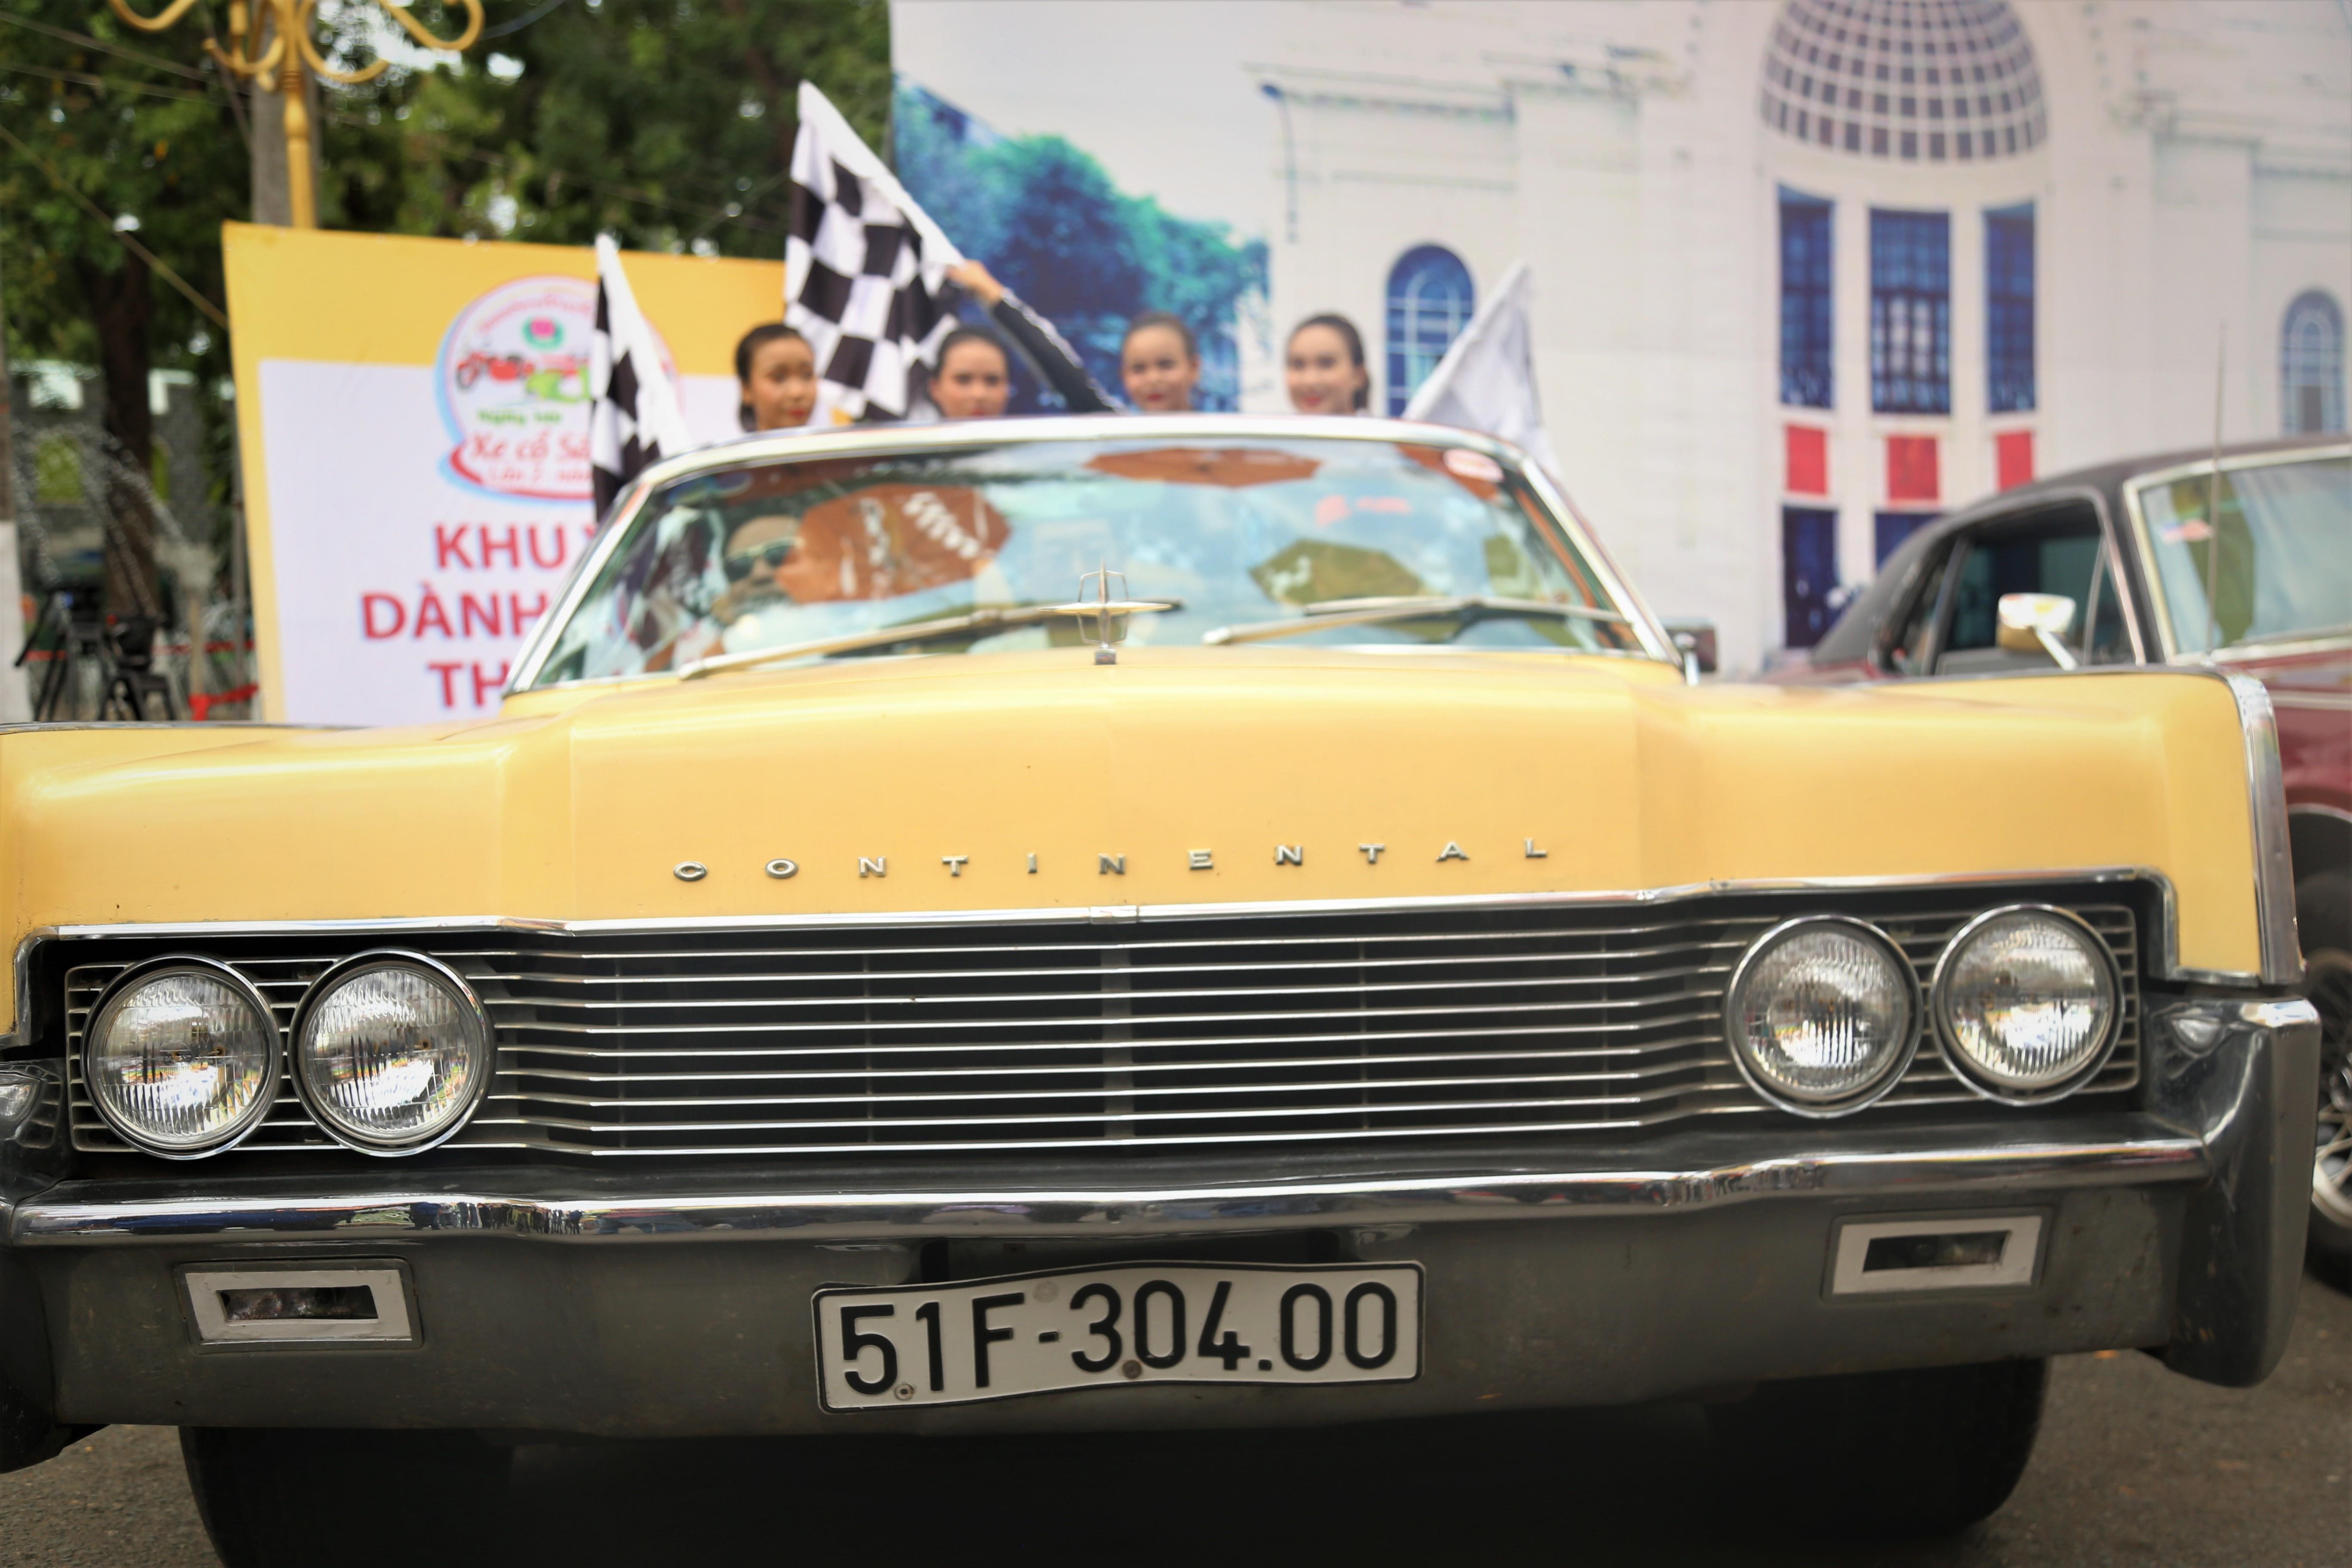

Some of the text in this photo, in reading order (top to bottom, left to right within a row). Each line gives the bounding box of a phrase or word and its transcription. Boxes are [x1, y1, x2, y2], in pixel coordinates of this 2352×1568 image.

[433, 524, 567, 570] KHU
[361, 580, 548, 638] DÀNH
[426, 661, 511, 707] TH
[673, 839, 1547, 882] CONTINENTAL
[839, 1279, 1397, 1395] 51F-304.00
